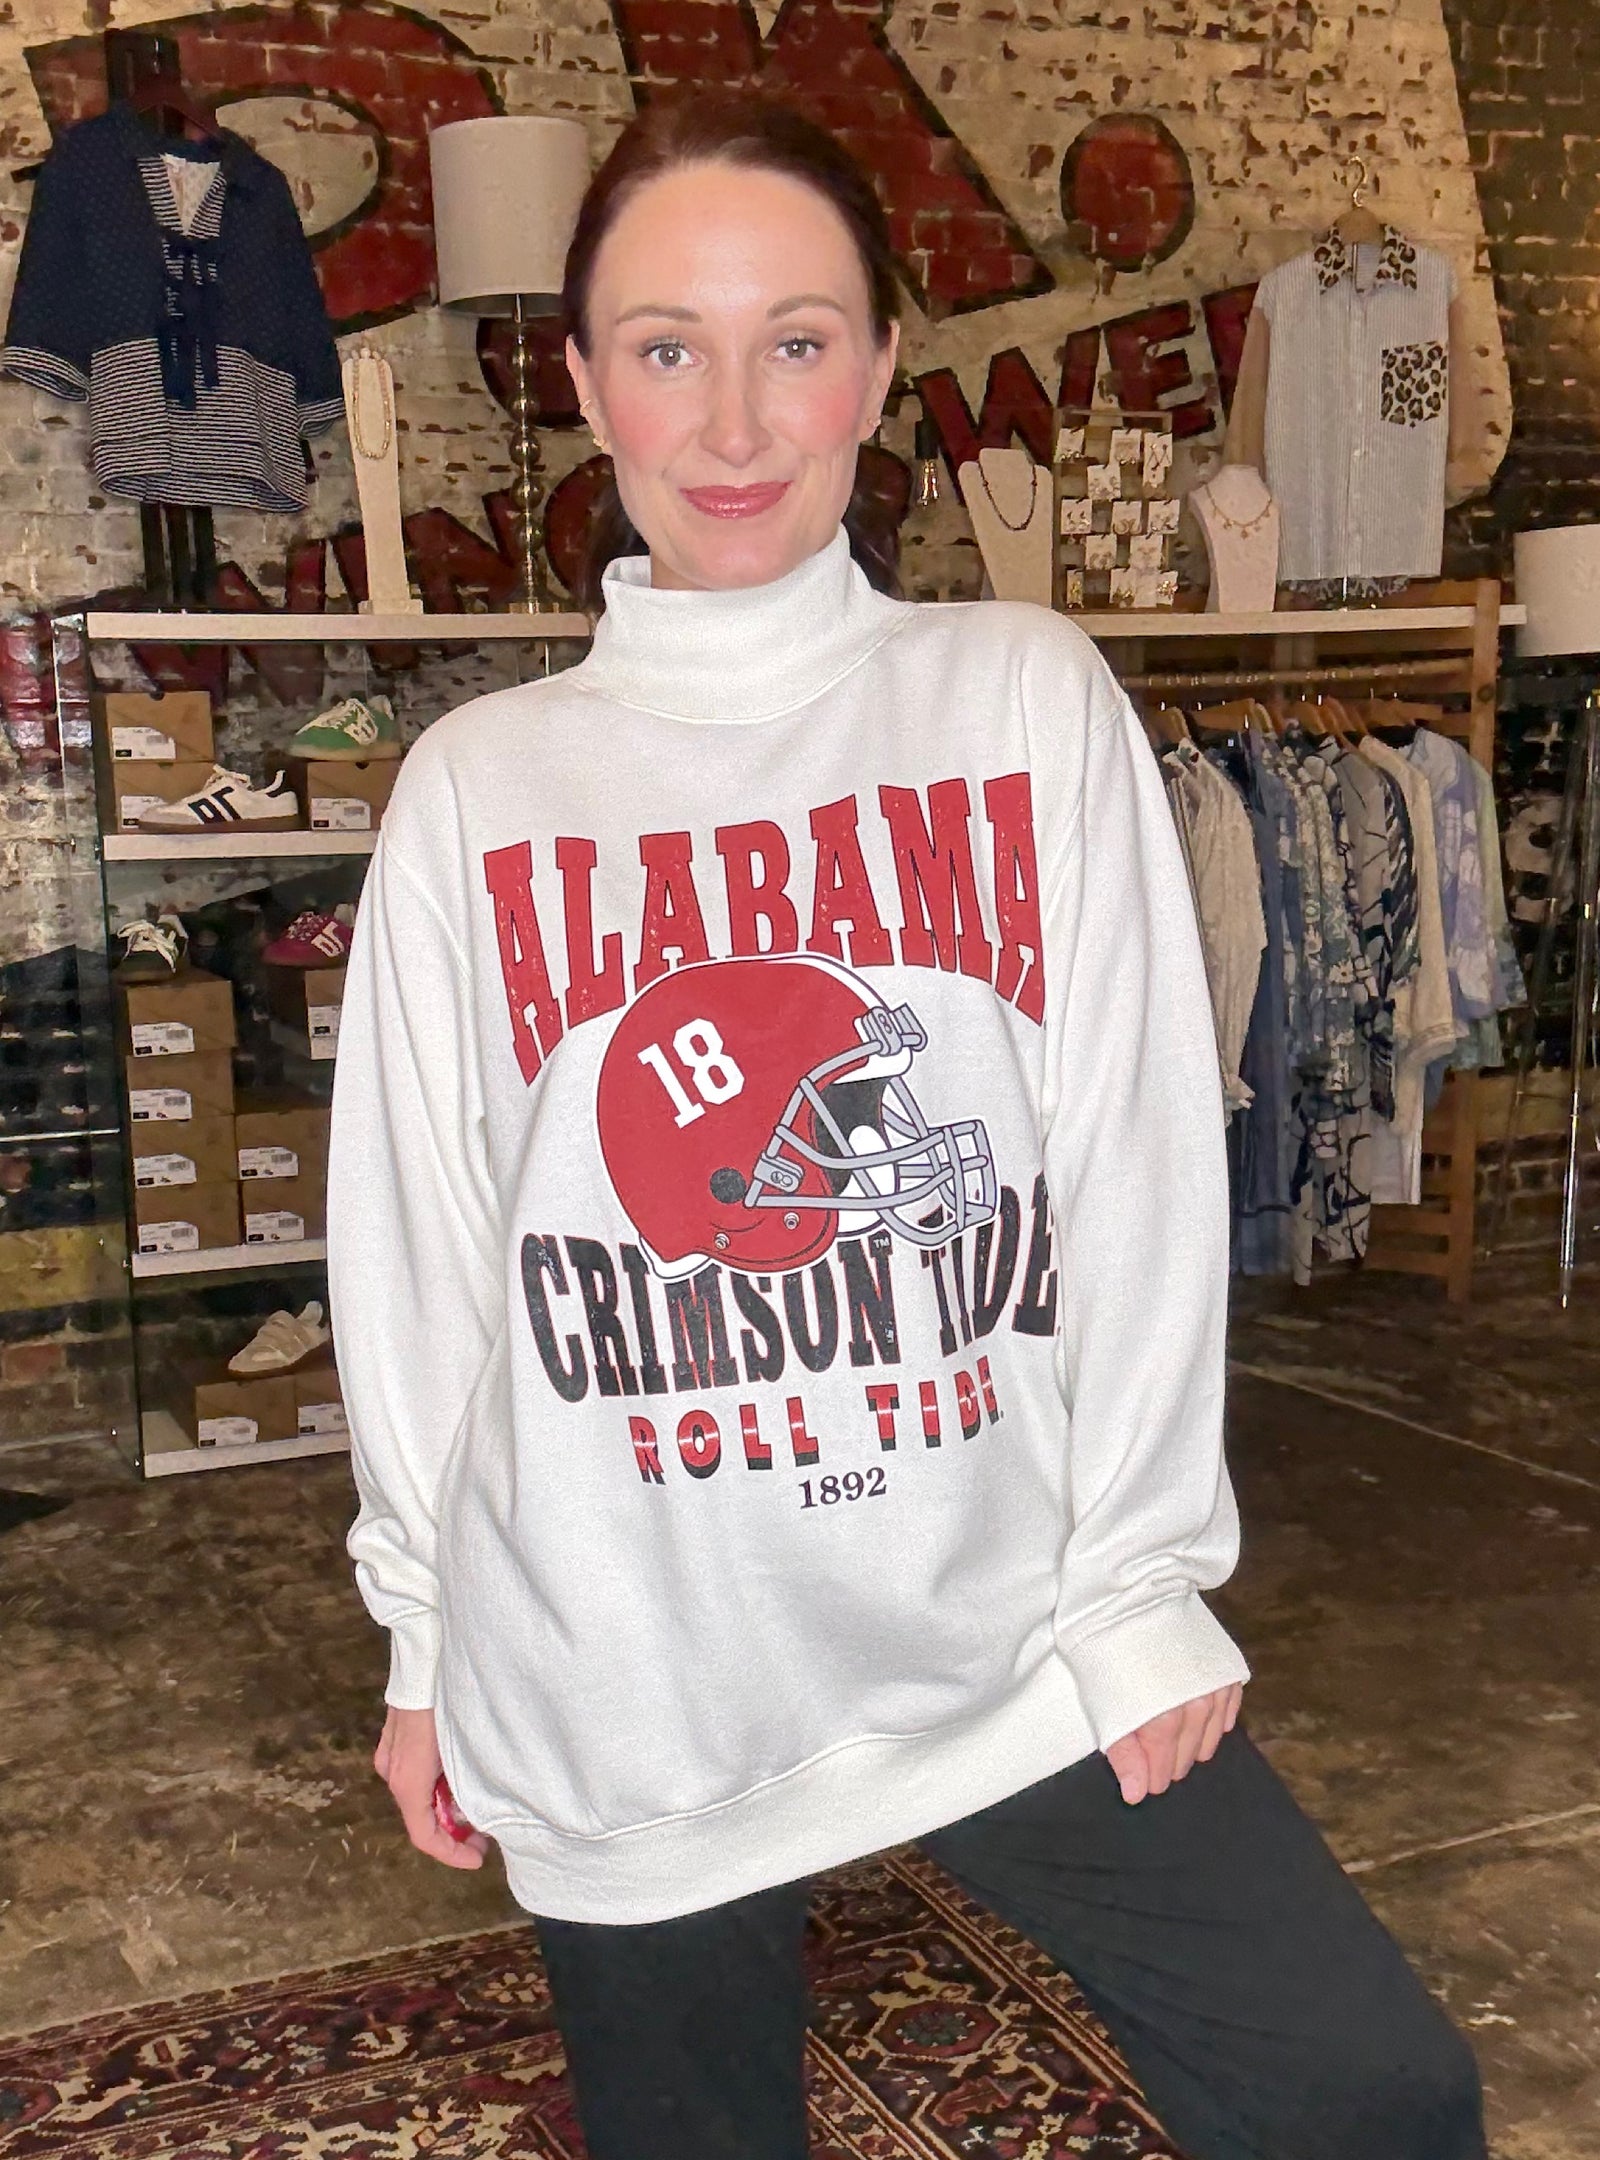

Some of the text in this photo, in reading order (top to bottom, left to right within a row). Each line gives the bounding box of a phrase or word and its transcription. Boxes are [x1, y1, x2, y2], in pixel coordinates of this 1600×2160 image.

[483, 772, 1046, 1088] ALABAMA
[637, 1017, 746, 1129] 18
[520, 1228, 901, 1403] CRIMSON
[627, 1396, 820, 1486] ROLL
[798, 1466, 888, 1509] 1892
